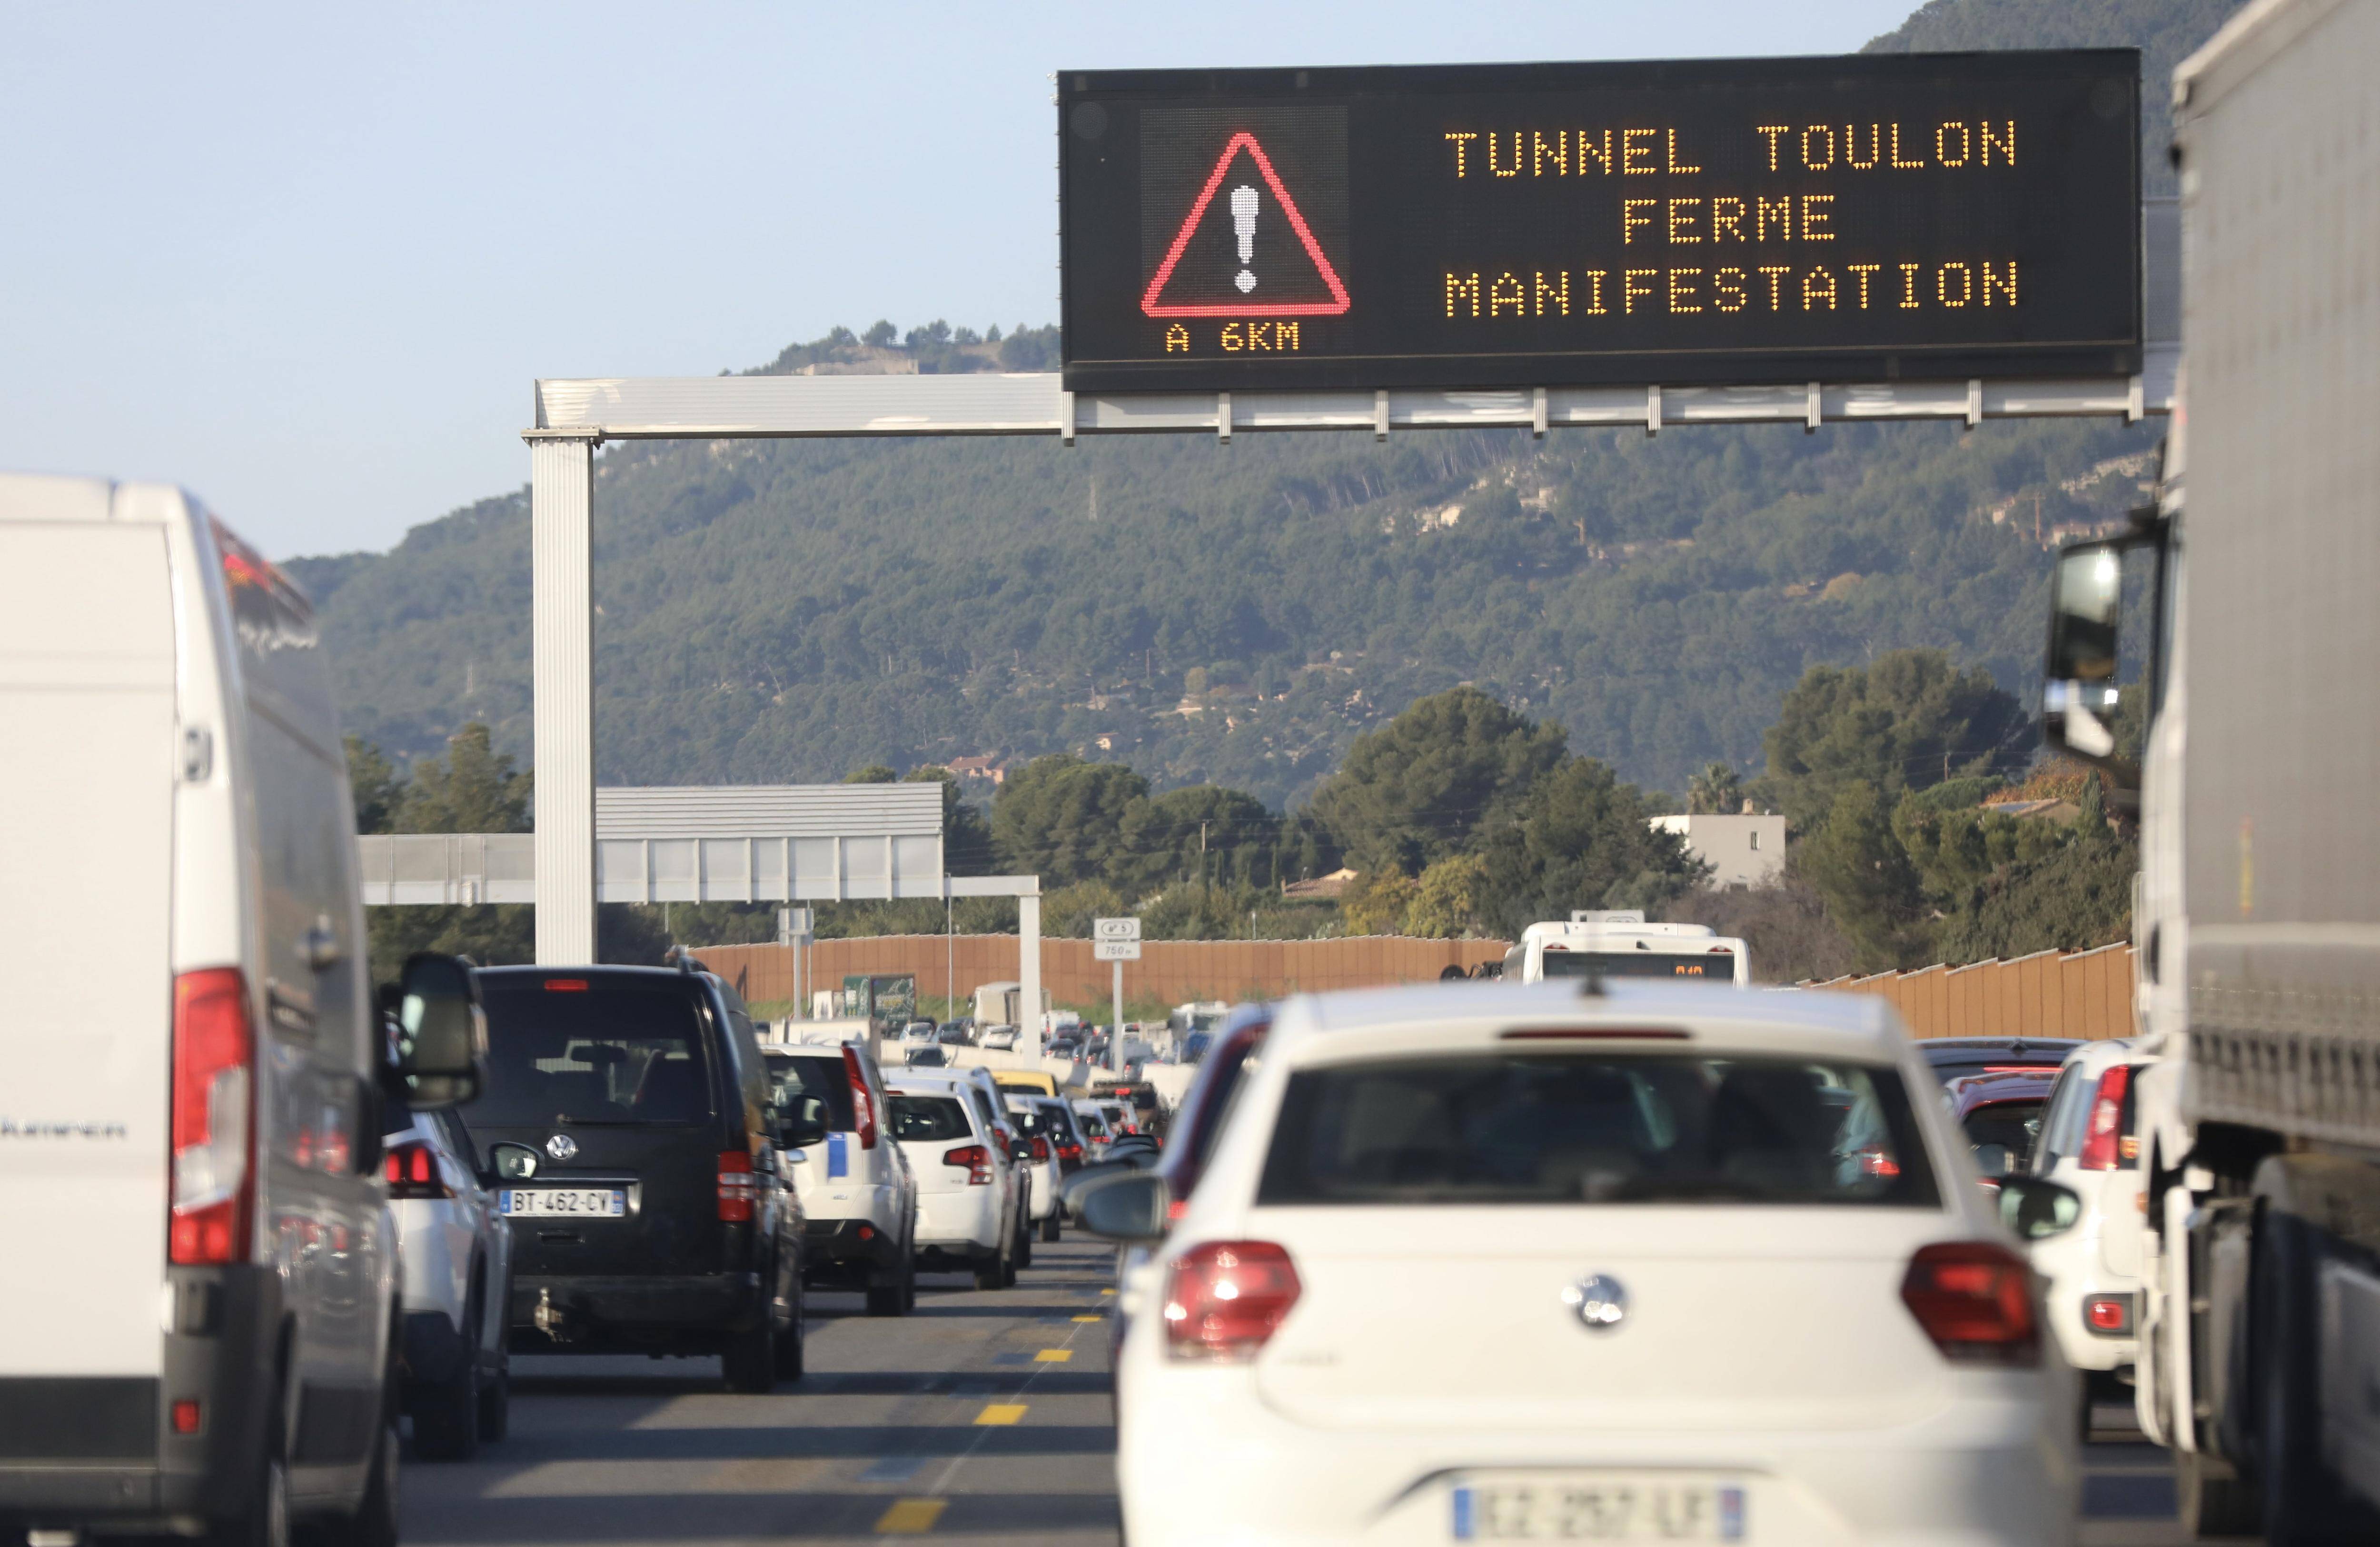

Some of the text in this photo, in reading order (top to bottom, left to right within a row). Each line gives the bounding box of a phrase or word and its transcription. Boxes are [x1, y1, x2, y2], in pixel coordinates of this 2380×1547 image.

[1445, 120, 2014, 178] TUNNEL TOULON
[1624, 195, 1835, 244] FERME
[1447, 261, 2016, 317] MANIFESTATION
[1166, 322, 1299, 352] A 6KM
[1106, 946, 1124, 955] 750
